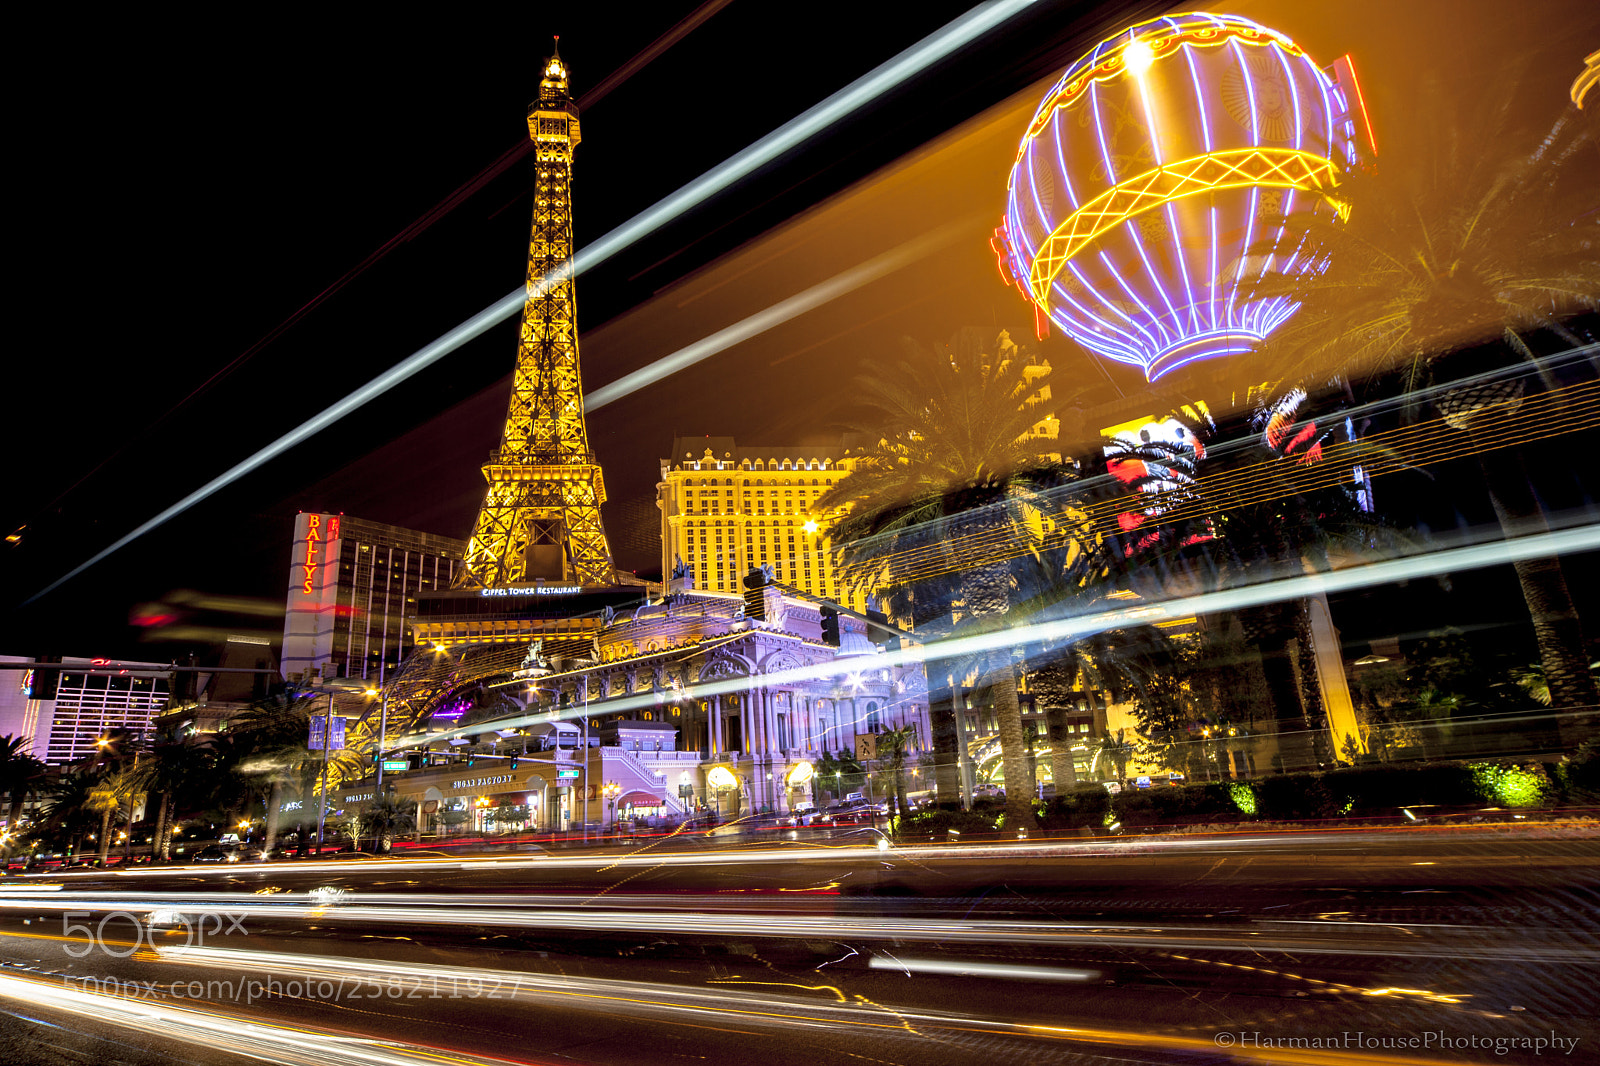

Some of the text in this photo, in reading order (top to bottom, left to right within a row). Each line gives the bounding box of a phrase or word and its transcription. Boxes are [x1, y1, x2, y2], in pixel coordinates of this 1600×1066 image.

[482, 586, 581, 596] EIFFEL TOWER RESTAURANT
[453, 775, 513, 788] SUGAR FACTORY
